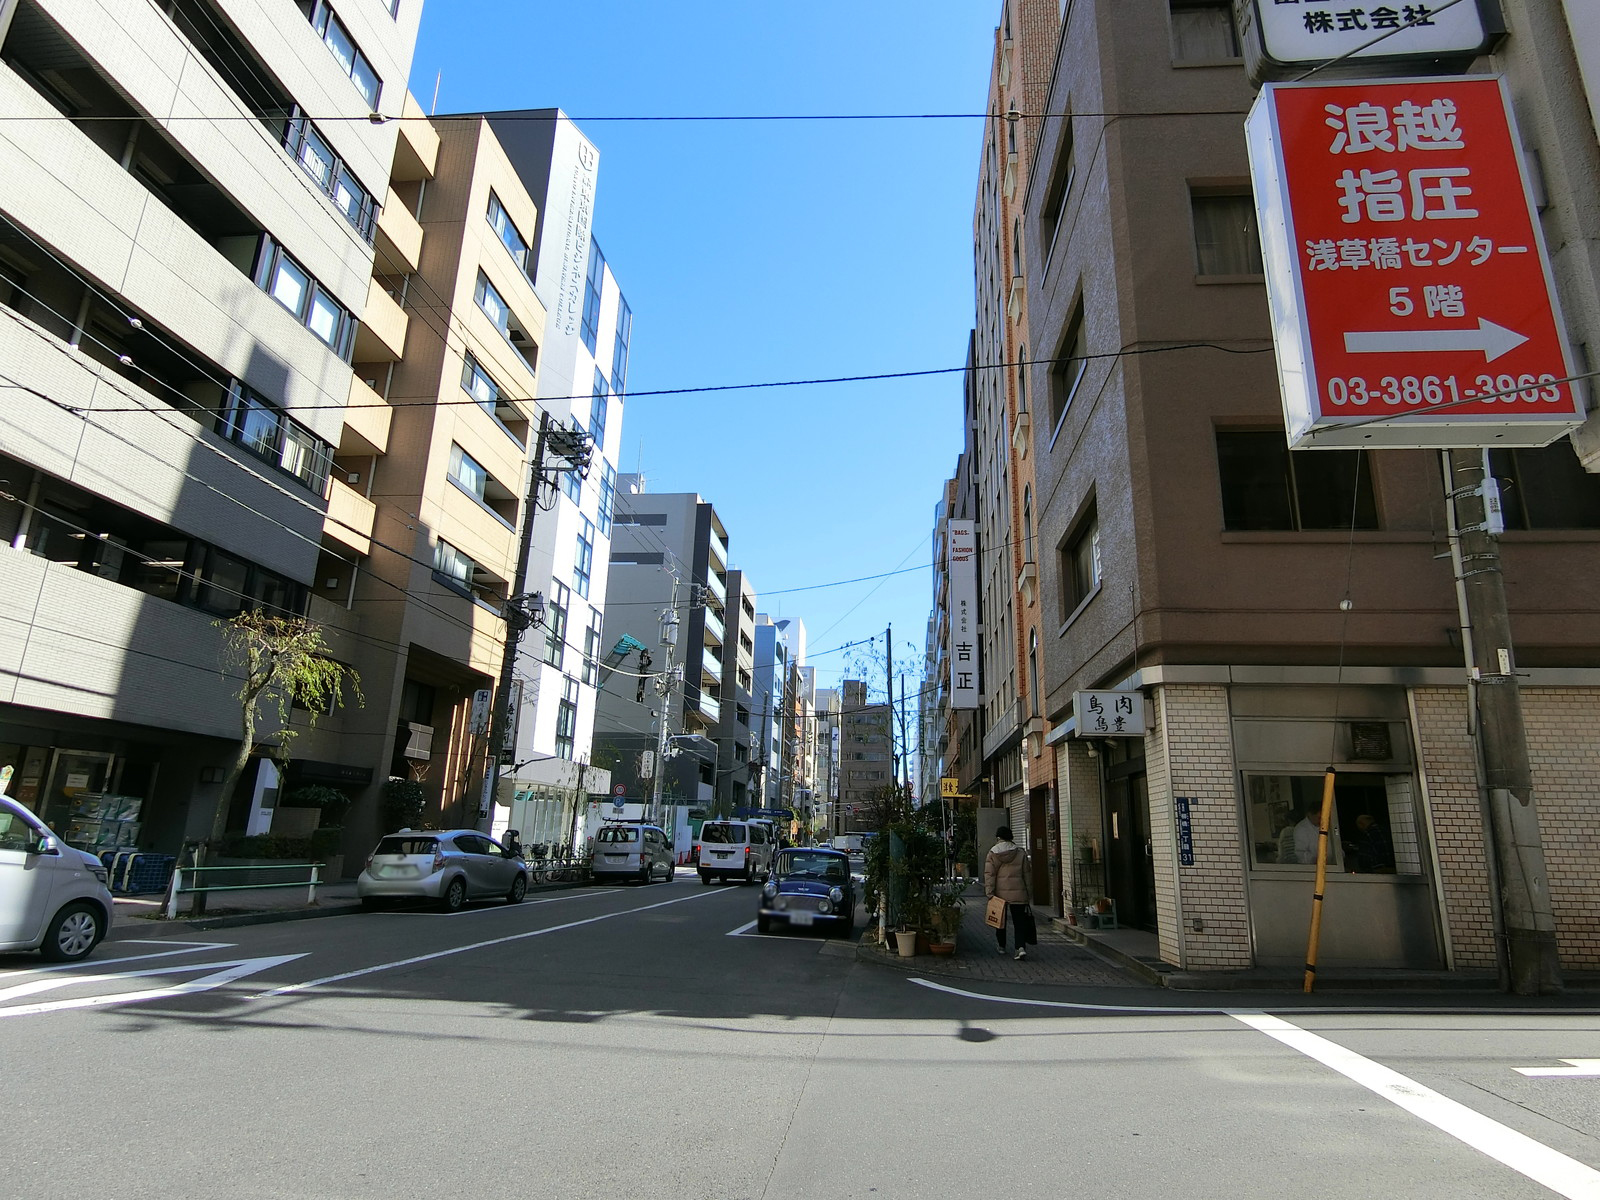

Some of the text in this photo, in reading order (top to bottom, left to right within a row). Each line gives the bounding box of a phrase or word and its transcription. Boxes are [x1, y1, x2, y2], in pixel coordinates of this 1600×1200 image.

[1303, 5, 1435, 35] 株式会社
[1324, 98, 1465, 154] 浪越
[1336, 167, 1479, 224] 指圧
[1305, 235, 1528, 272] 浅草橋センター
[1328, 373, 1561, 406] 03-3861-3963
[955, 641, 974, 689] 吉正
[1087, 694, 1132, 715] 鳥肉
[1183, 853, 1192, 862] 31
